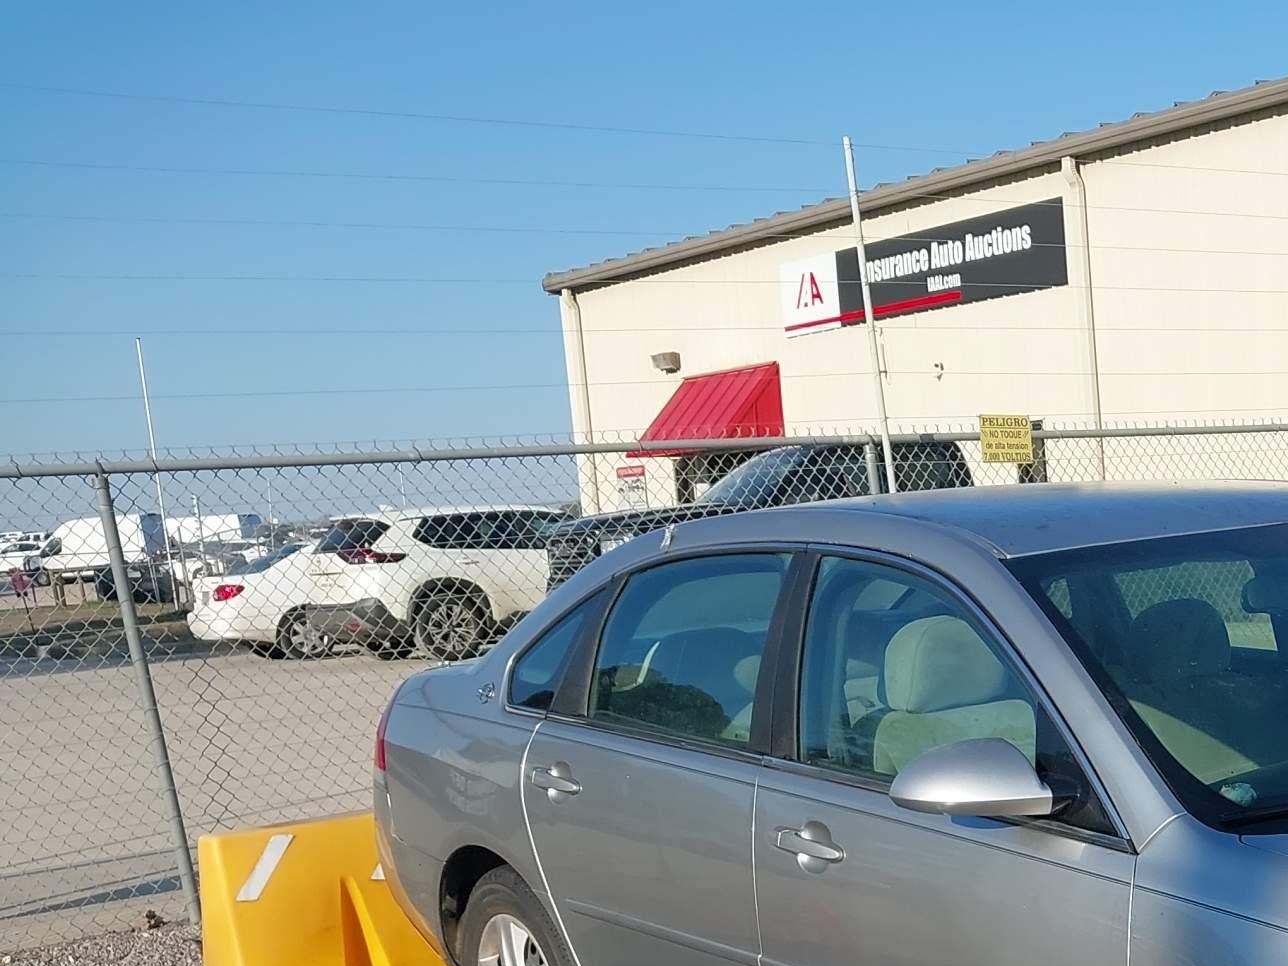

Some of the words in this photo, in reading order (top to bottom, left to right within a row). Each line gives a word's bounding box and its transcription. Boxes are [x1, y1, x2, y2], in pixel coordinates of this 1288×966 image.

[864, 248, 929, 284] nsurance
[930, 240, 963, 269] Auto
[965, 224, 1032, 261] Auctions
[982, 417, 1029, 427] PELIGRO
[989, 430, 999, 439] NO
[1000, 430, 1022, 439] TOQUE
[1000, 452, 1031, 462] VOLTIOS
